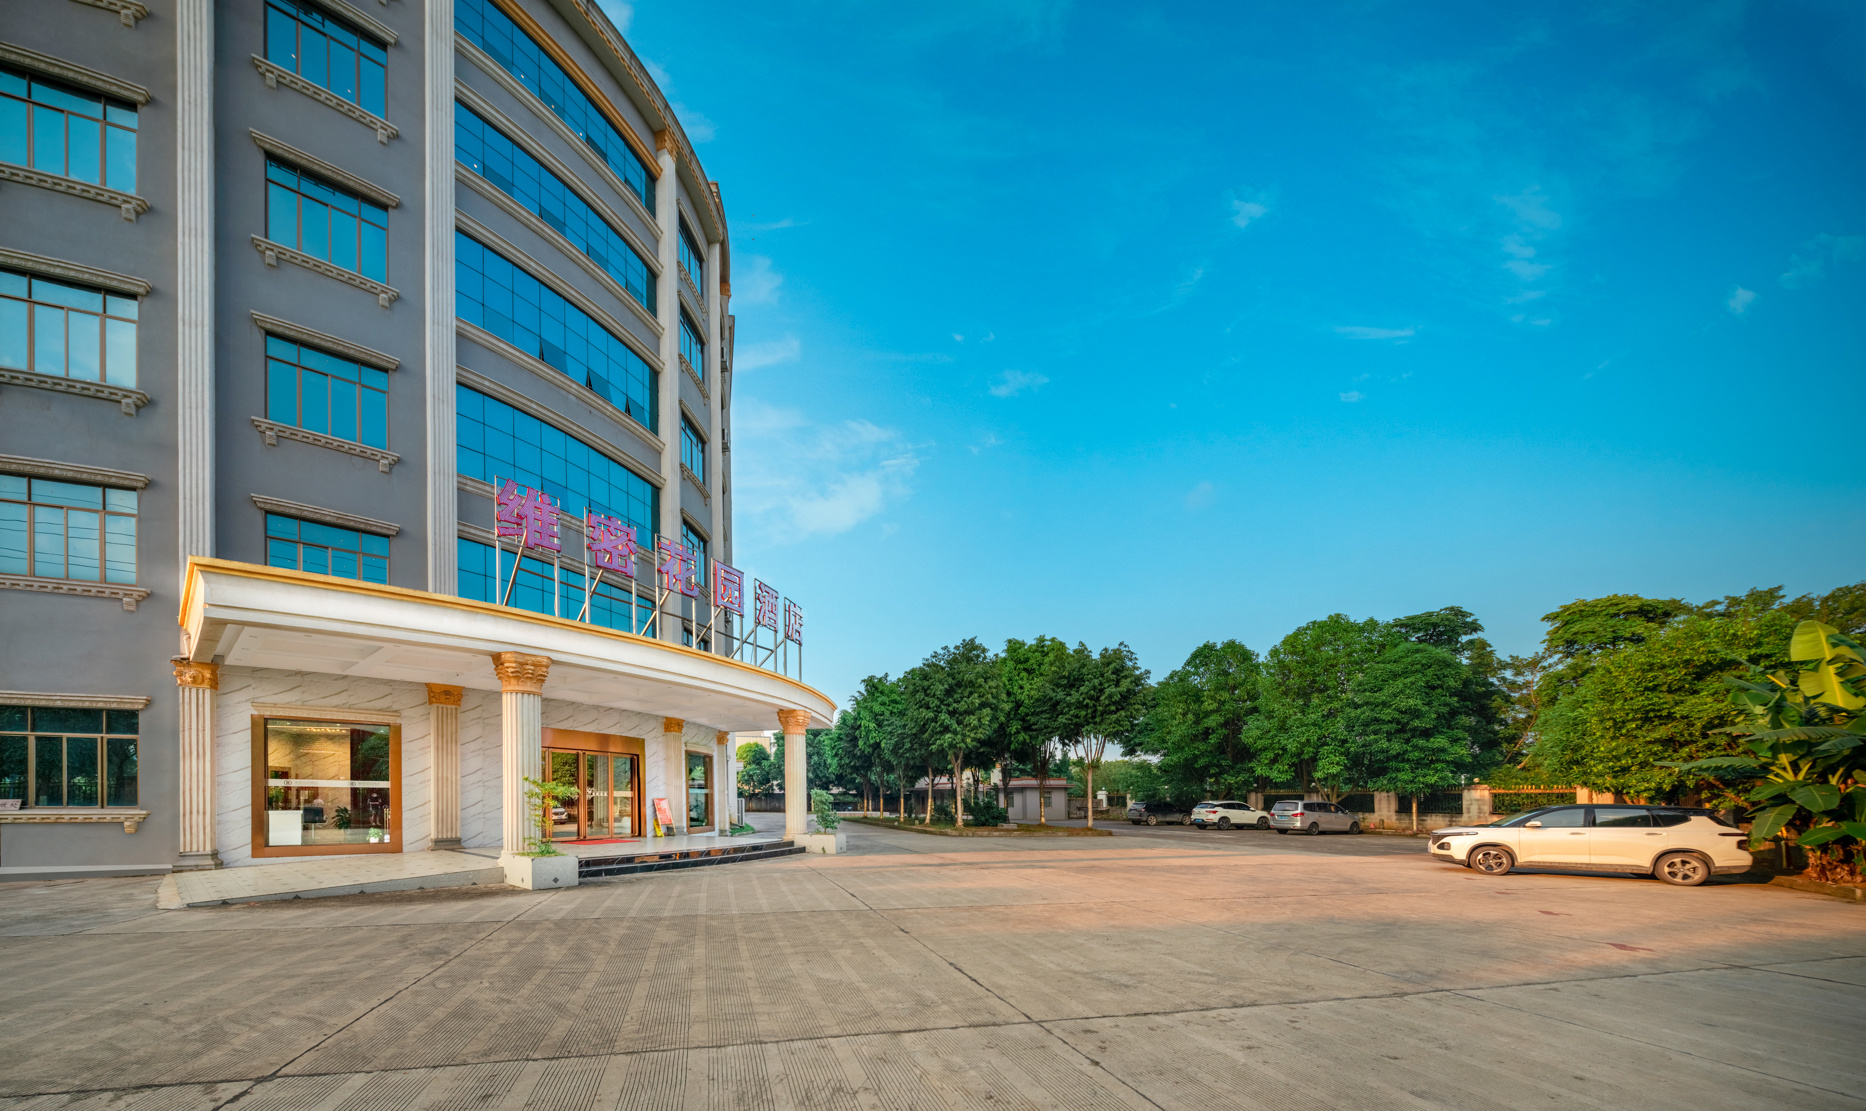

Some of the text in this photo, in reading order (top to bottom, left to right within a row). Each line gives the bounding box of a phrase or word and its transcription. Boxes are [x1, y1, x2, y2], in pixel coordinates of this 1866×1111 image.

[497, 478, 803, 645] 维密花园酒店
